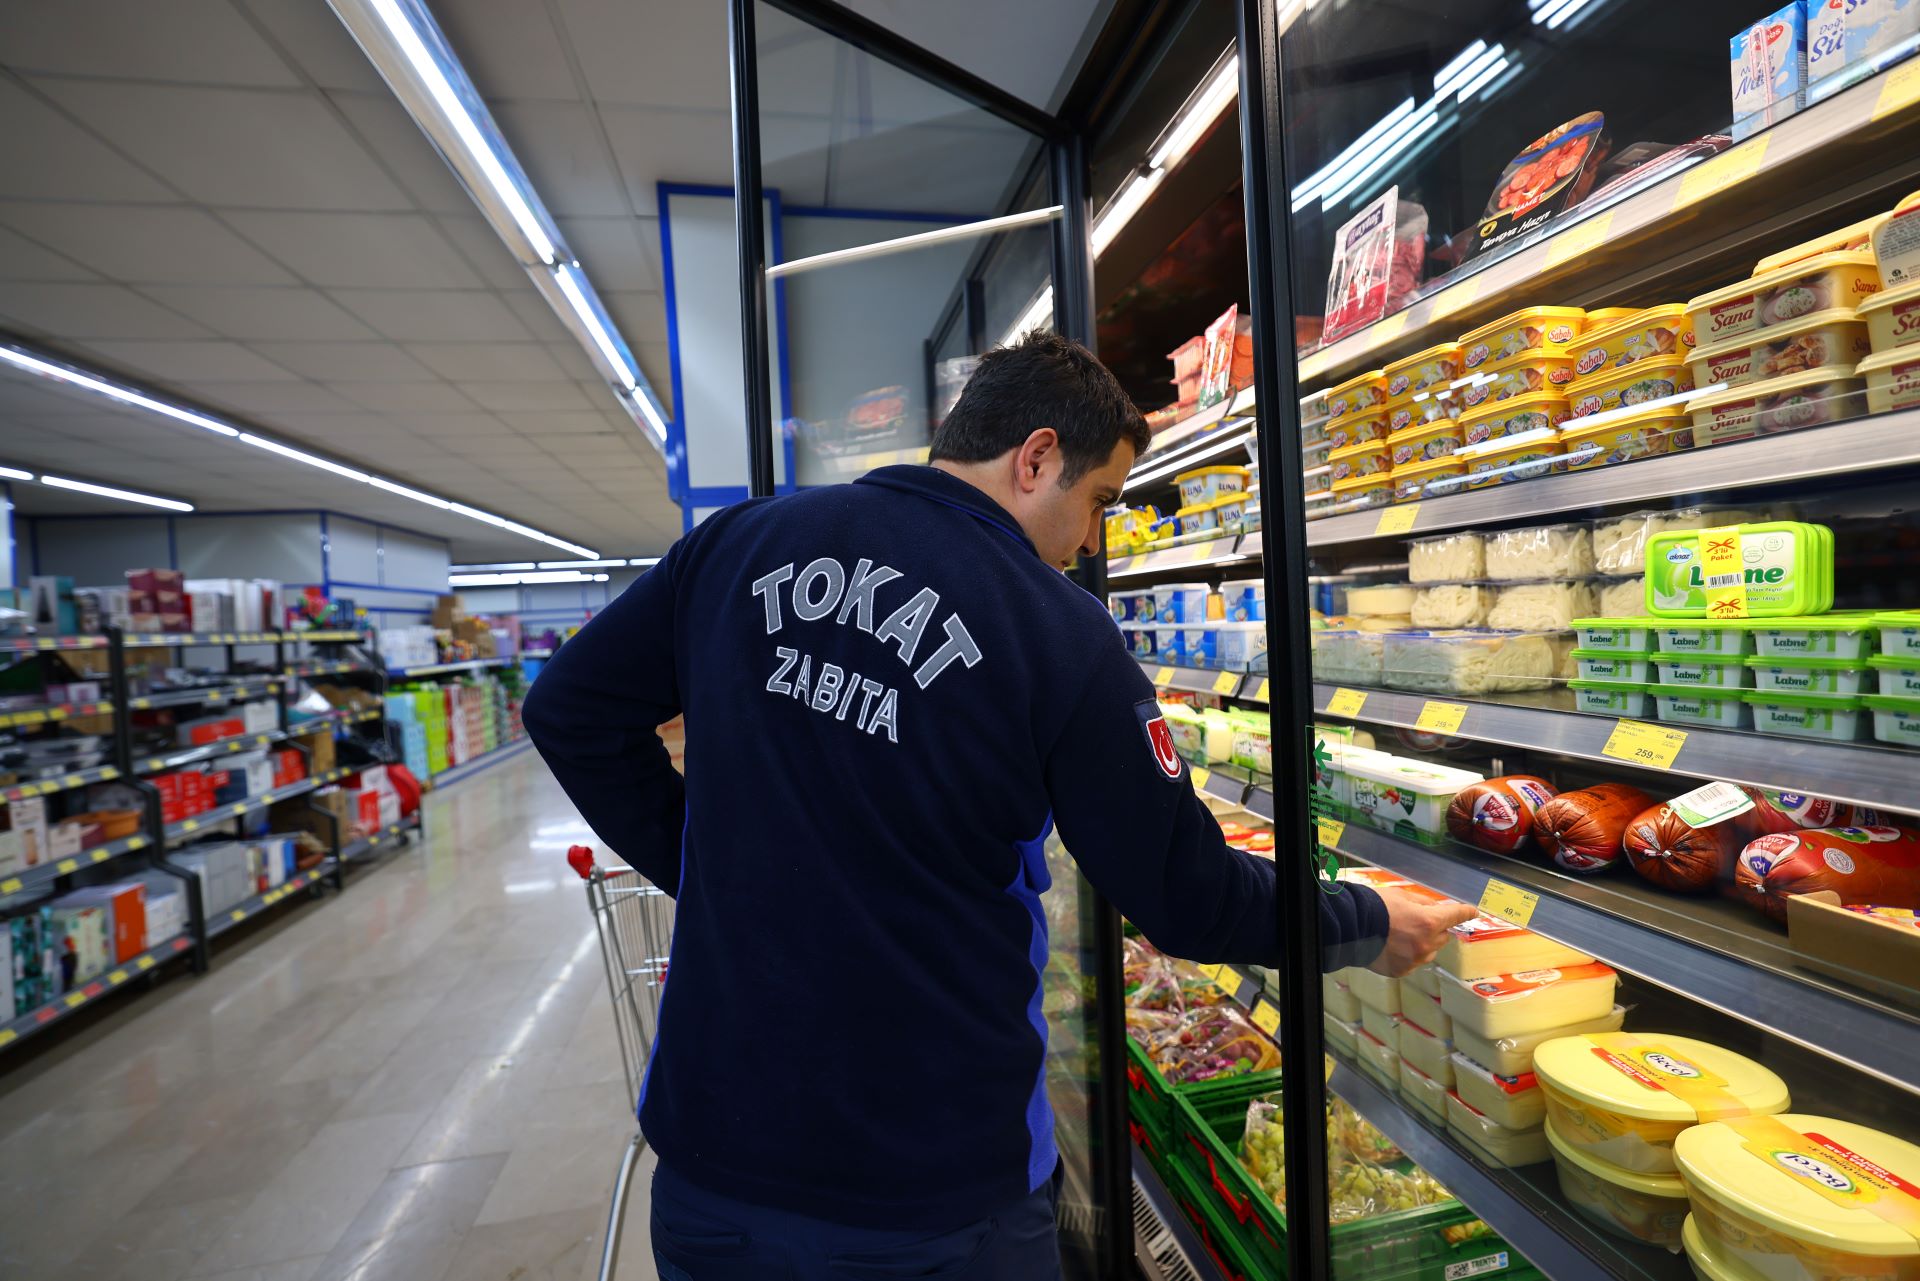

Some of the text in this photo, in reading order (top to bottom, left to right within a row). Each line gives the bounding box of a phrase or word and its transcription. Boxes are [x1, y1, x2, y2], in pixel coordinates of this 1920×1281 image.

[1810, 30, 1844, 63] Sü
[1512, 192, 1546, 214] NAMET
[1852, 279, 1877, 293] Sana
[1711, 308, 1754, 332] Sana
[1893, 314, 1920, 336] Sa
[1550, 328, 1573, 342] Sabah
[1465, 346, 1489, 366] Sabah
[1577, 352, 1606, 373] Sabah
[1550, 369, 1574, 382] Sabah
[1709, 362, 1751, 384] Sana
[1573, 398, 1602, 420] Sabah
[1710, 414, 1752, 431] Sana
[1468, 426, 1490, 445] Sabah
[1690, 565, 1785, 586] Lne
[752, 557, 982, 690] TOKAT
[1589, 635, 1612, 643] Labne
[1672, 637, 1699, 646] Labne
[1773, 638, 1807, 647] Labne
[1907, 638, 1920, 648] La
[1590, 665, 1613, 673] Labne
[1674, 670, 1701, 679] Labne
[1775, 676, 1809, 686] Labne
[1906, 680, 1920, 689] La
[766, 646, 899, 744] ZABITA
[1587, 696, 1610, 705] Labne
[1672, 704, 1700, 713] Labne
[1771, 712, 1805, 724] Labne
[1649, 1054, 1691, 1077] Becel
[1784, 1154, 1848, 1189] Becel
[1471, 1256, 1497, 1268] TRENTO
